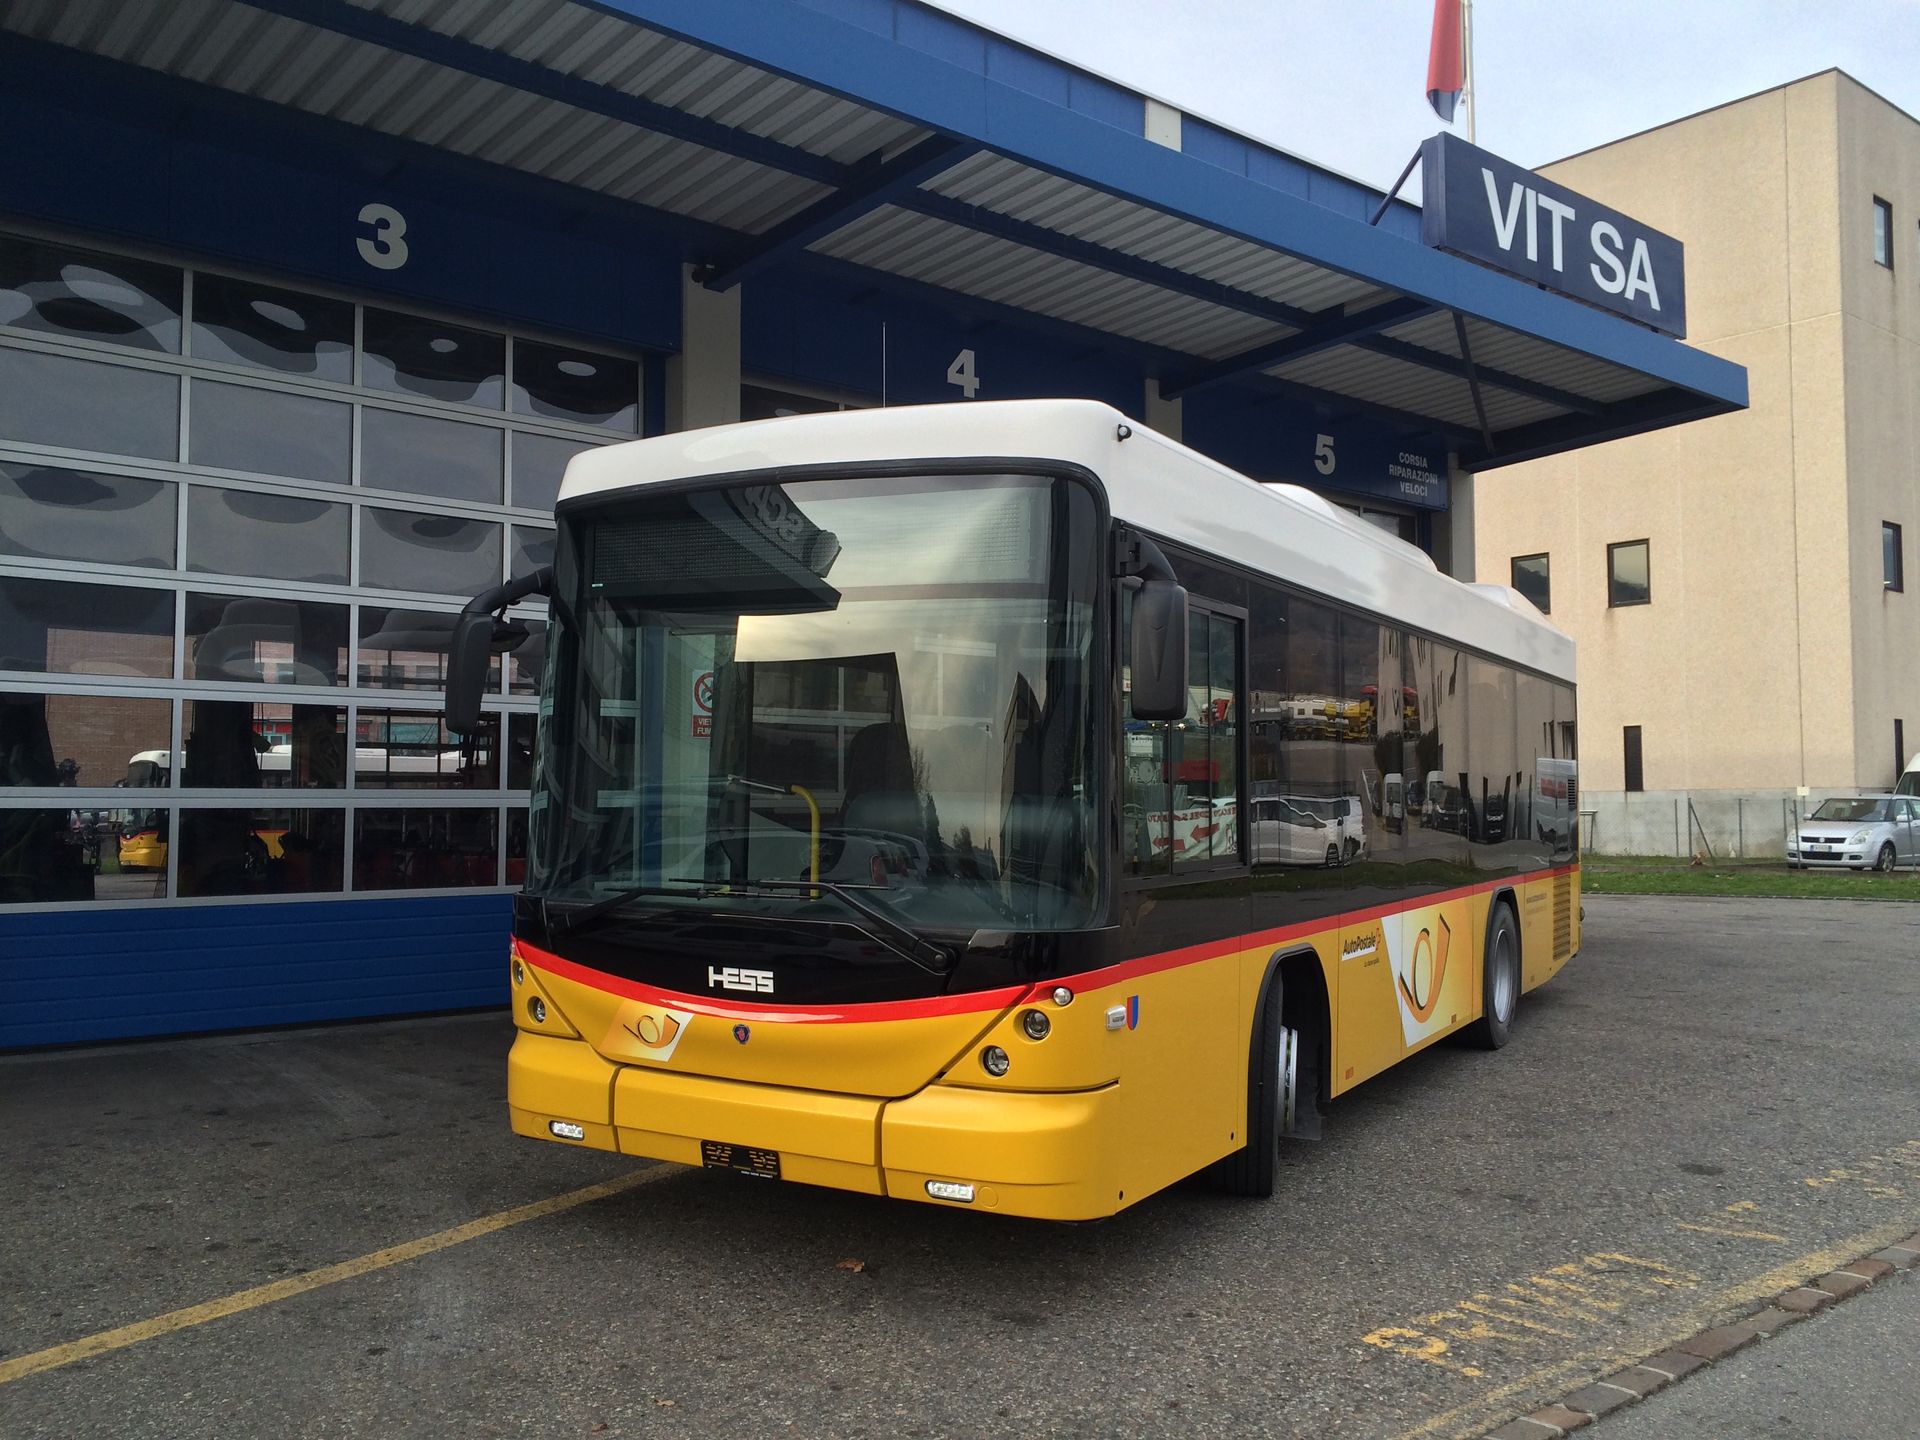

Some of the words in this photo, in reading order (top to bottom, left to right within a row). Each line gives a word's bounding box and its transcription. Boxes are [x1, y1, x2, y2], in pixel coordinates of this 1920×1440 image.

[355, 202, 409, 270] 3
[1481, 167, 1576, 273] VIT
[1589, 220, 1662, 312] SA
[946, 348, 980, 399] 4
[1314, 433, 1336, 475] 5
[1398, 452, 1428, 469] CORSIA
[1388, 464, 1438, 485] RIPARAZIONI
[1399, 481, 1428, 497] VELOCI
[707, 965, 775, 994] HESS
